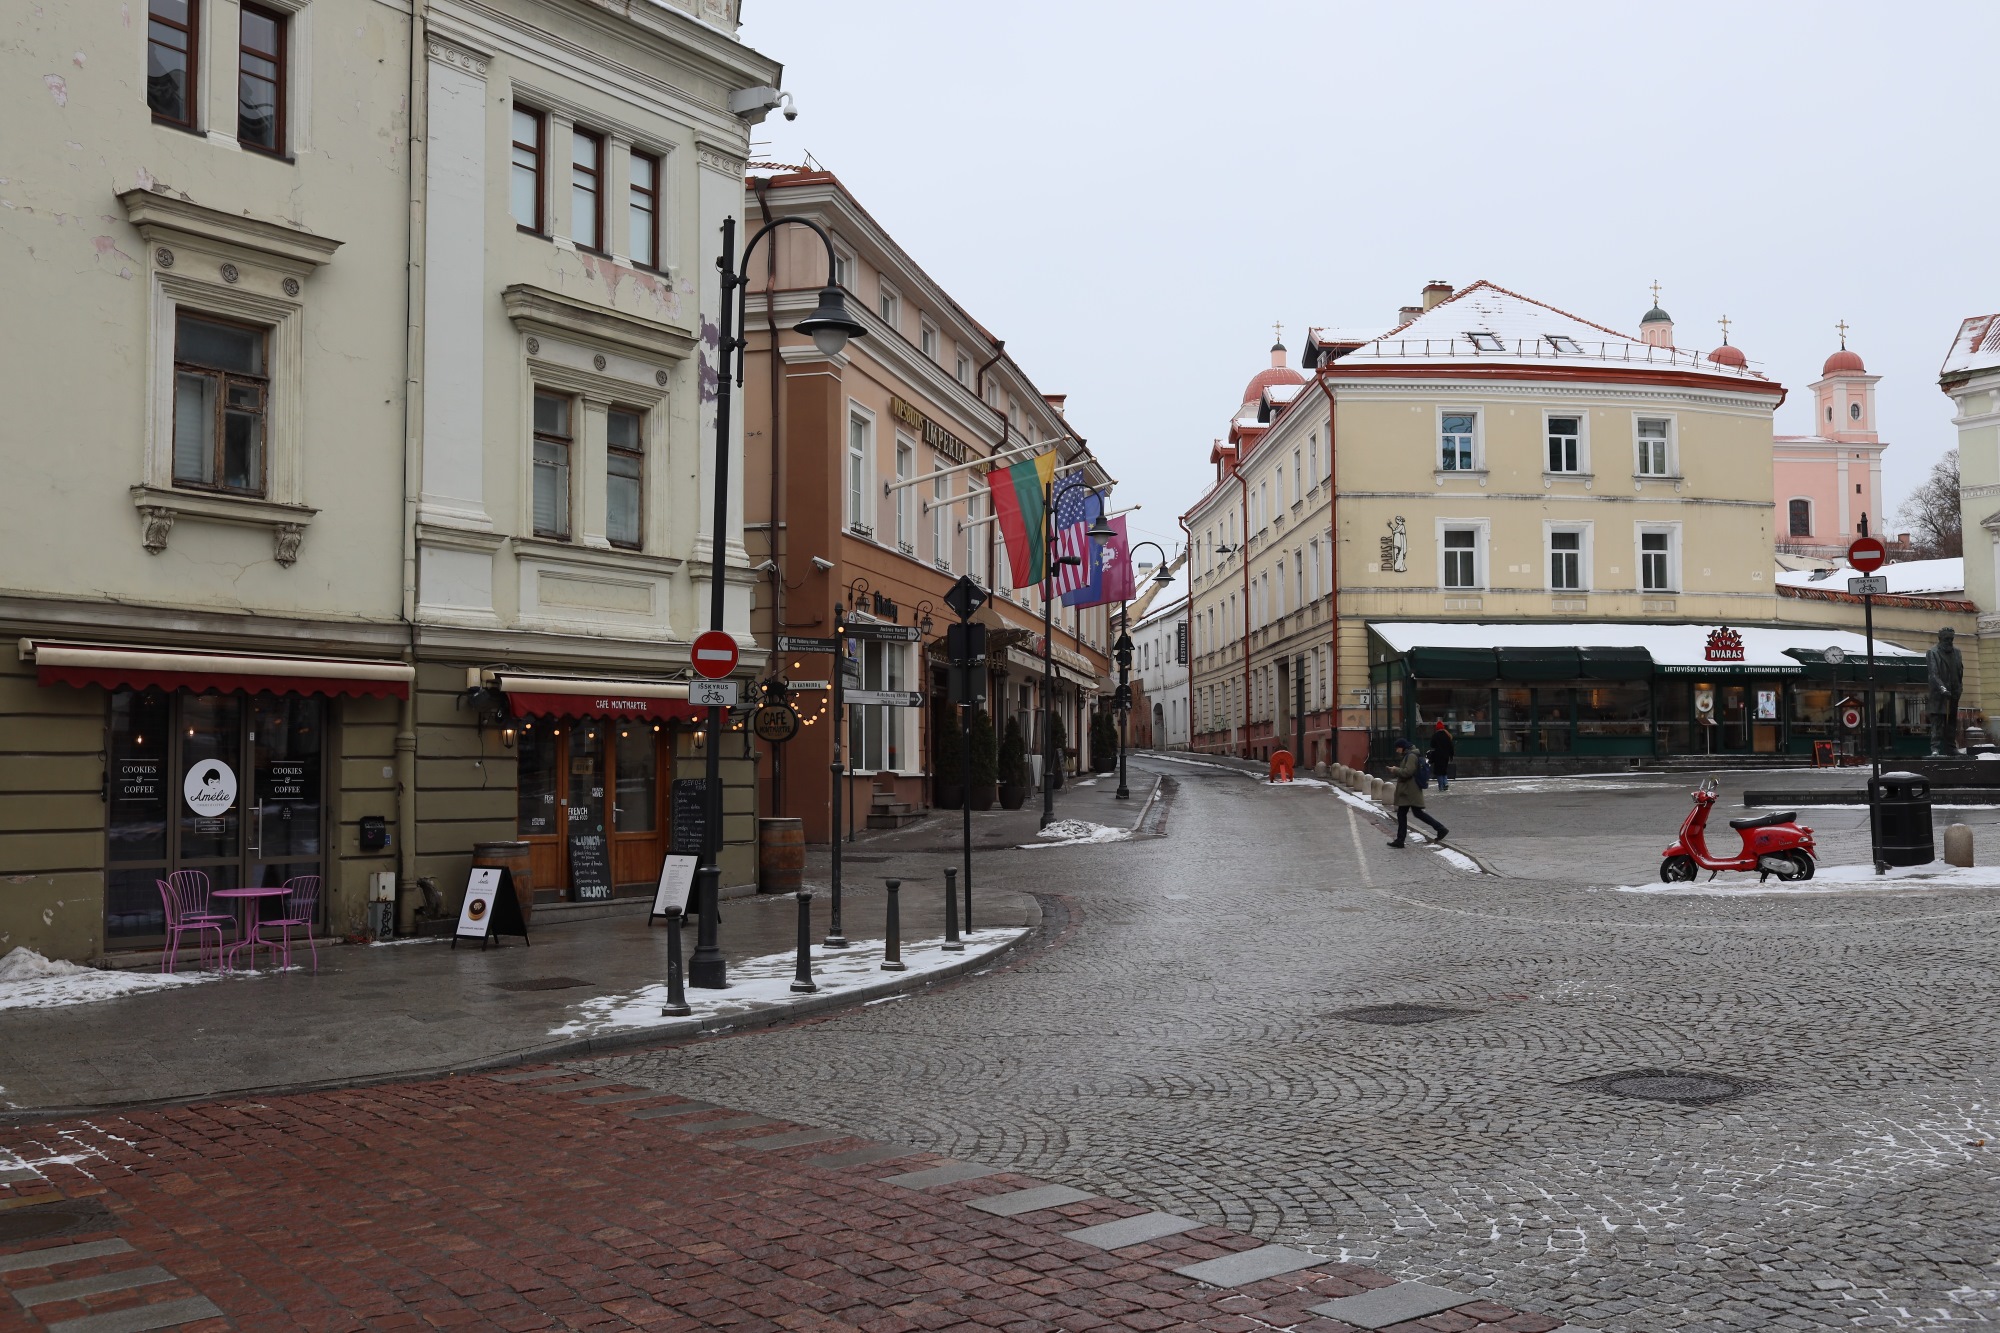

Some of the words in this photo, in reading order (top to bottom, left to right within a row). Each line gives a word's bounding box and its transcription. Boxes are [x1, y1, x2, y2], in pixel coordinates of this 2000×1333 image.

[892, 398, 924, 431] VIEŠBUTIS
[1380, 536, 1393, 572] IDABASAR
[1718, 640, 1736, 648] ETNO
[1710, 650, 1742, 658] DVARAS
[1664, 665, 1697, 673] LIETUVIŠKI
[1363, 695, 1367, 703] 2
[595, 699, 609, 709] CAFÉ
[611, 700, 647, 711] MONTMARTRE
[763, 710, 786, 725] CAFÉ
[272, 767, 303, 775] COOKIES
[135, 776, 143, 784] &
[190, 789, 231, 802] Amélie
[568, 807, 588, 816] FRENCH
[580, 885, 608, 898] ENJOY
